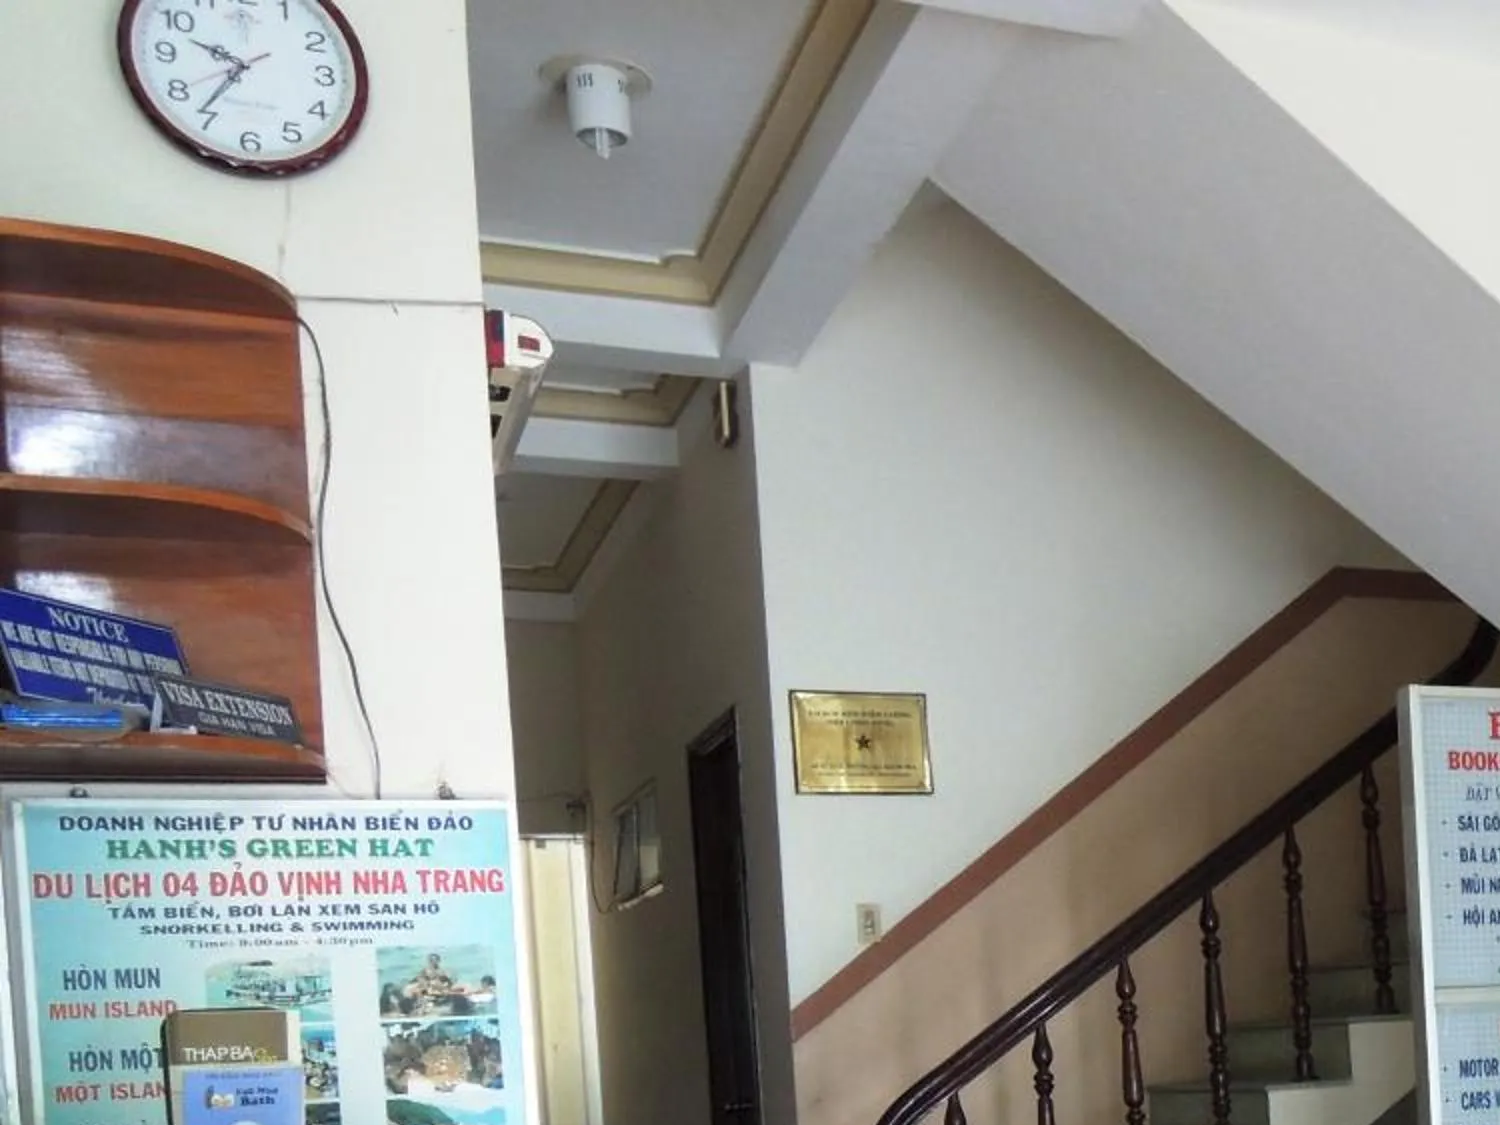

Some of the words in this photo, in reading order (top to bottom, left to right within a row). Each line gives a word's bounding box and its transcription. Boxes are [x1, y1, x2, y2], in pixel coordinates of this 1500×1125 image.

[160, 10, 194, 32] 10
[155, 42, 176, 63] 9
[305, 32, 326, 53] 2
[315, 66, 335, 86] 3
[167, 79, 190, 101] 8
[199, 109, 218, 130] 7
[308, 100, 329, 120] 4
[240, 131, 262, 152] 6
[282, 122, 302, 143] 5
[46, 605, 128, 643] NOTICE
[161, 681, 204, 709] VISA
[203, 690, 293, 725] EXTENSION
[59, 815, 144, 831] DOANH
[154, 811, 244, 834] NGHIỆP
[105, 838, 237, 860] HANH'S
[246, 837, 357, 859] GREEN
[367, 836, 434, 858] HAT
[32, 872, 73, 898] DU
[85, 871, 152, 904] LỊCH
[162, 871, 199, 897] 04
[209, 862, 269, 898] ĐẢO
[277, 870, 342, 901] VỊNH
[353, 869, 407, 895] NHA
[415, 868, 505, 894] TRANG
[319, 903, 361, 917] XEM
[368, 903, 407, 915] SAN
[140, 922, 284, 935] SNORKELLING
[290, 921, 305, 933] &
[311, 919, 415, 933] SWIMMING
[115, 967, 161, 989] MUN
[49, 1001, 97, 1021] MUN
[105, 1000, 177, 1019] ISLAND
[1459, 1057, 1499, 1078] MOTOR
[110, 1082, 168, 1100] ISLAN
[1461, 1091, 1492, 1111] CARS
